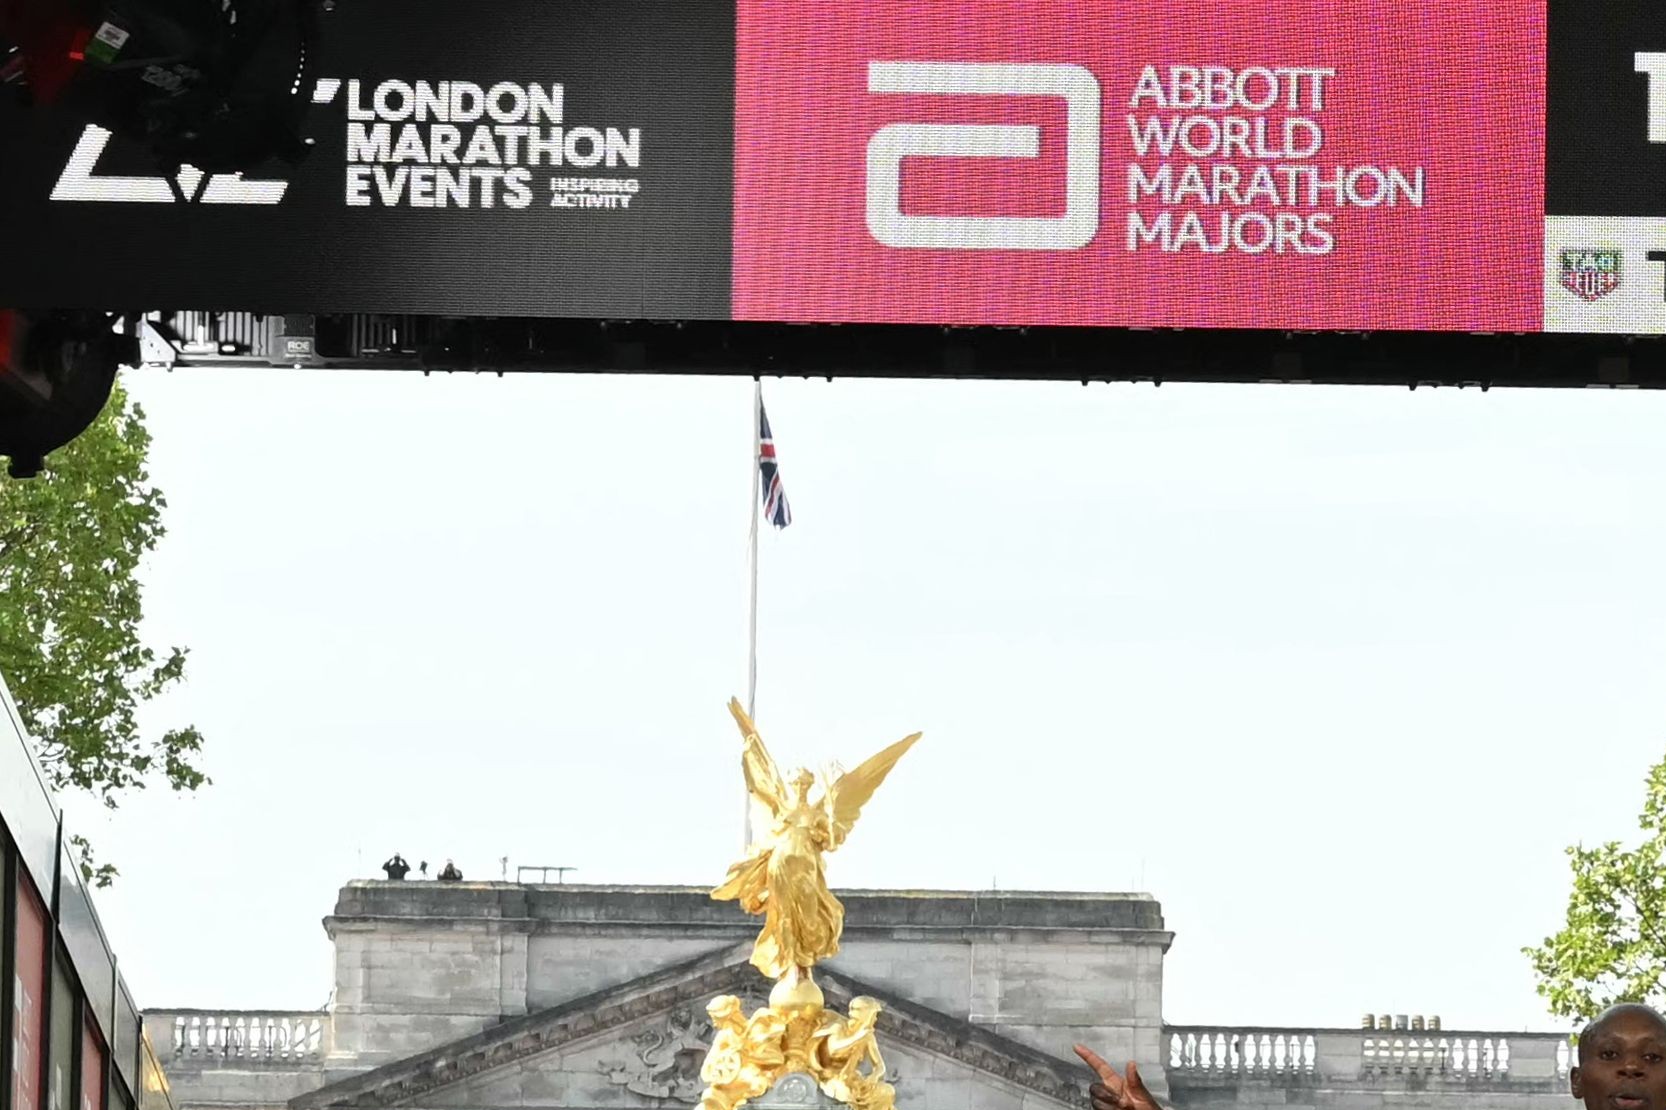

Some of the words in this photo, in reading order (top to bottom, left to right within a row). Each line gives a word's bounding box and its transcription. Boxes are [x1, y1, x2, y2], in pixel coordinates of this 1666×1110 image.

[347, 78, 564, 123] LONDON
[1128, 63, 1336, 110] ABBOTT
[347, 122, 641, 168] MARATHON
[1128, 115, 1324, 159] WORLD
[346, 164, 533, 208] EVENTS
[1127, 164, 1425, 208] MARATHON
[1126, 211, 1336, 255] MAJORS
